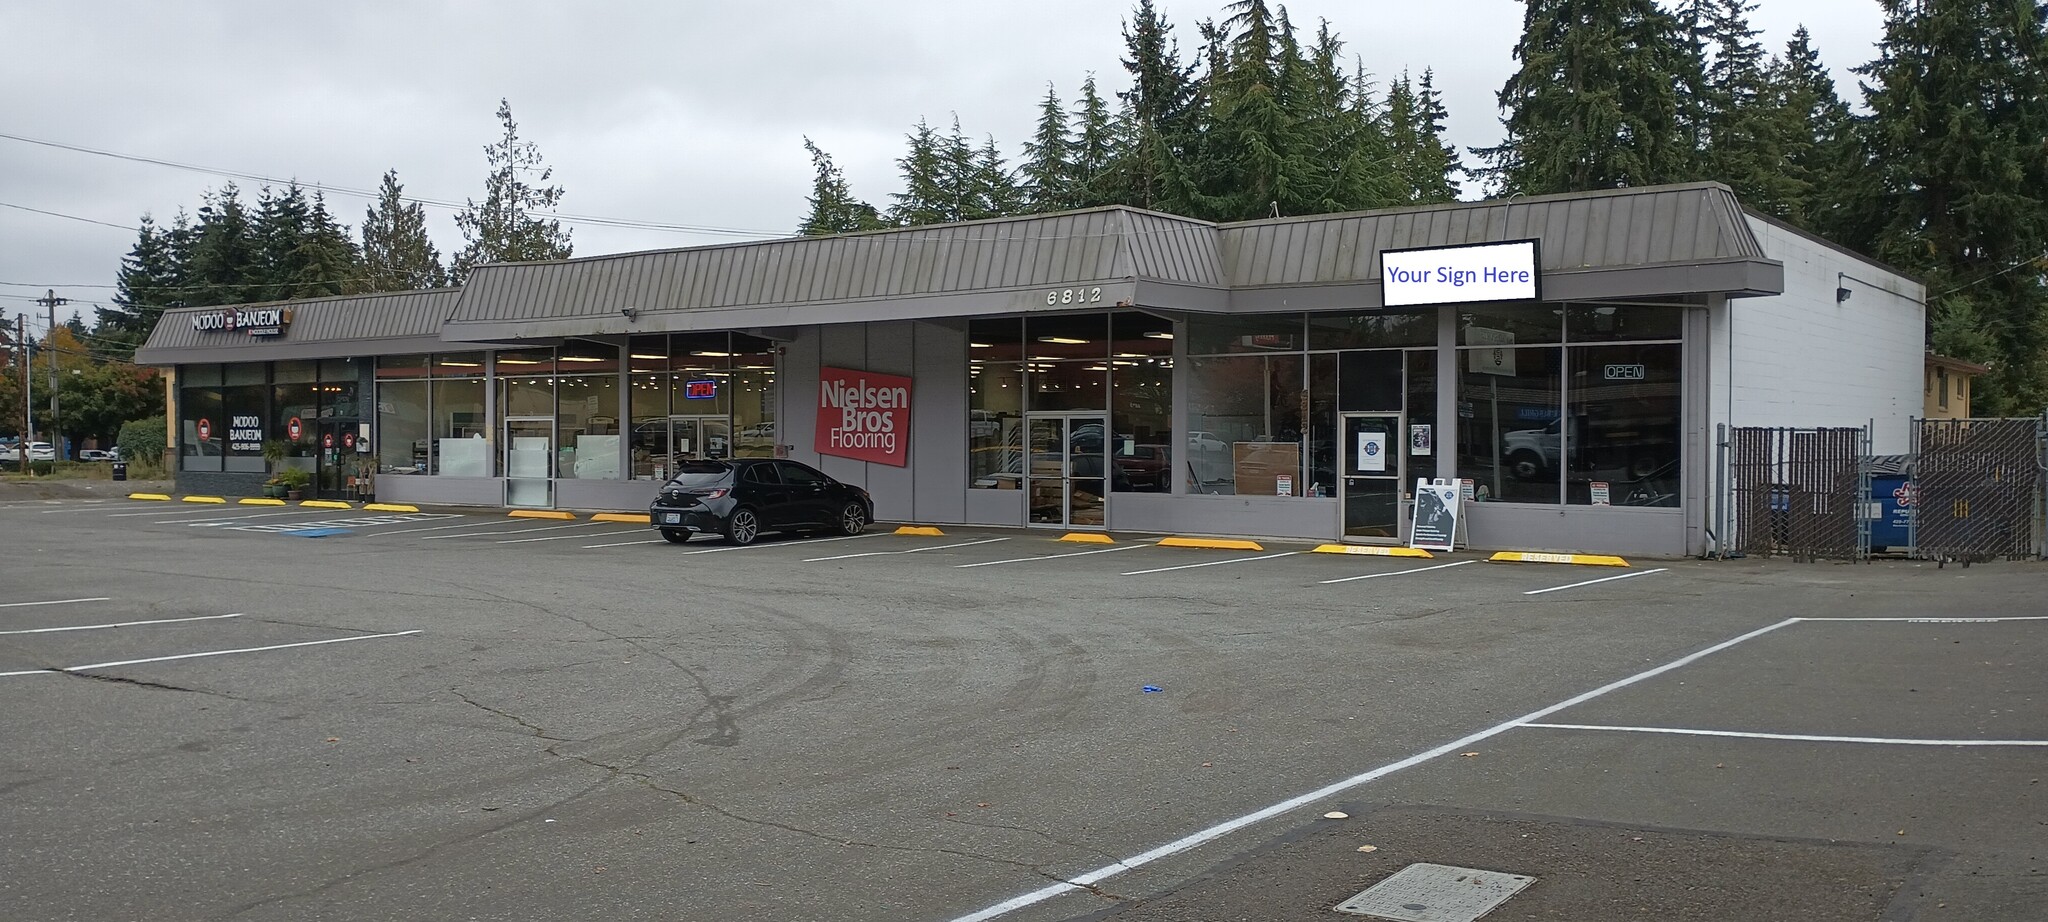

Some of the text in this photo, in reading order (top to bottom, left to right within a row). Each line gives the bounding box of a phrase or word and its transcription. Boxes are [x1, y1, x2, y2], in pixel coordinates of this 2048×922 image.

[1388, 267, 1529, 287] Your Sign Here
[1046, 287, 1102, 306] 6812
[192, 308, 280, 330] MODOO BANJEOM
[1606, 366, 1642, 378] OPEN
[687, 383, 714, 396] OPEN
[821, 377, 908, 409] Nielsen
[232, 416, 259, 428] MODOO
[842, 406, 893, 432] Bros
[229, 429, 262, 441] BANJEOM
[830, 428, 896, 454] Flooring
[1522, 553, 1572, 563] RESERVED
